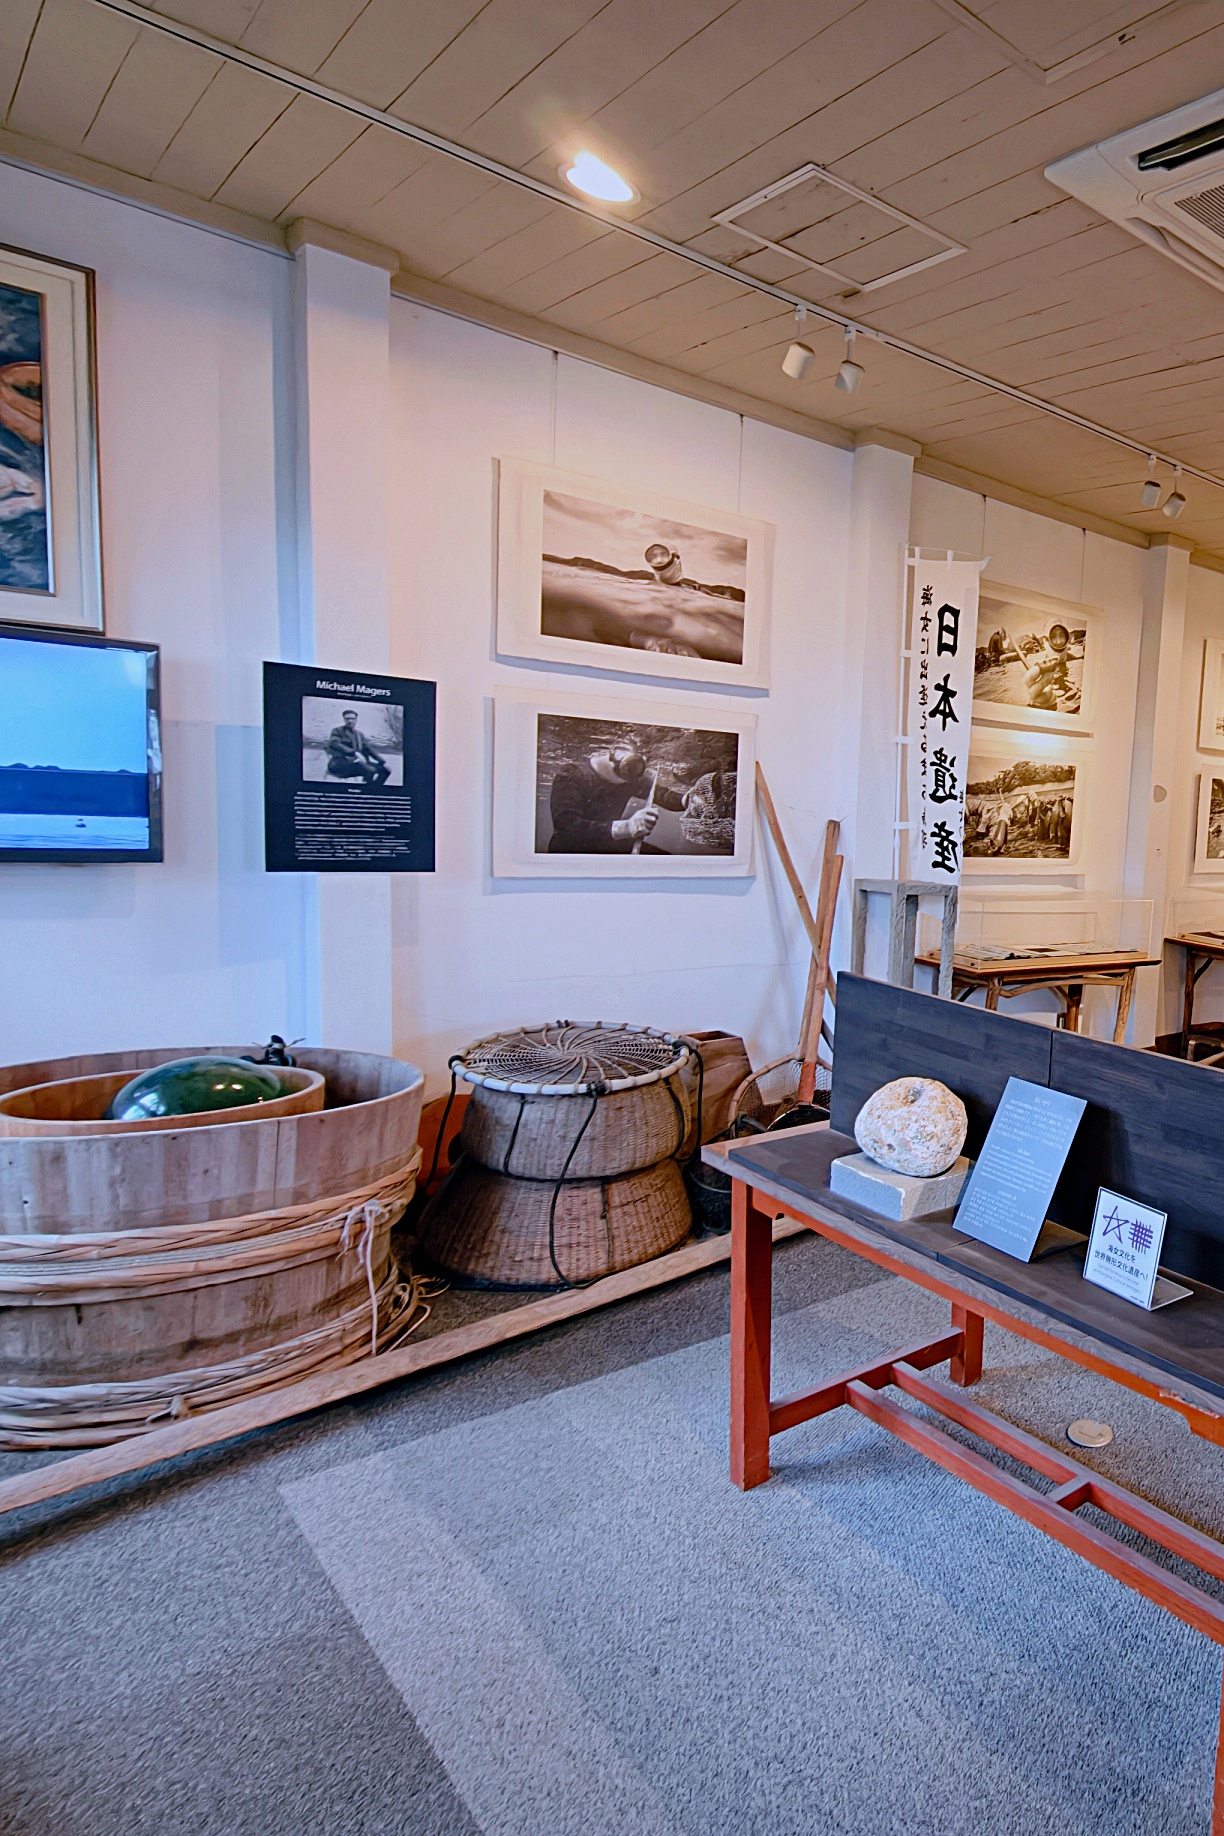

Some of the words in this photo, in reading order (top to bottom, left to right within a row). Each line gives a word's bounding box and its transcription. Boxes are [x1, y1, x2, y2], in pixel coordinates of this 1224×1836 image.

[315, 680, 355, 692] Michael
[356, 685, 392, 697] Magers
[1107, 1244, 1136, 1263] 海女文化を
